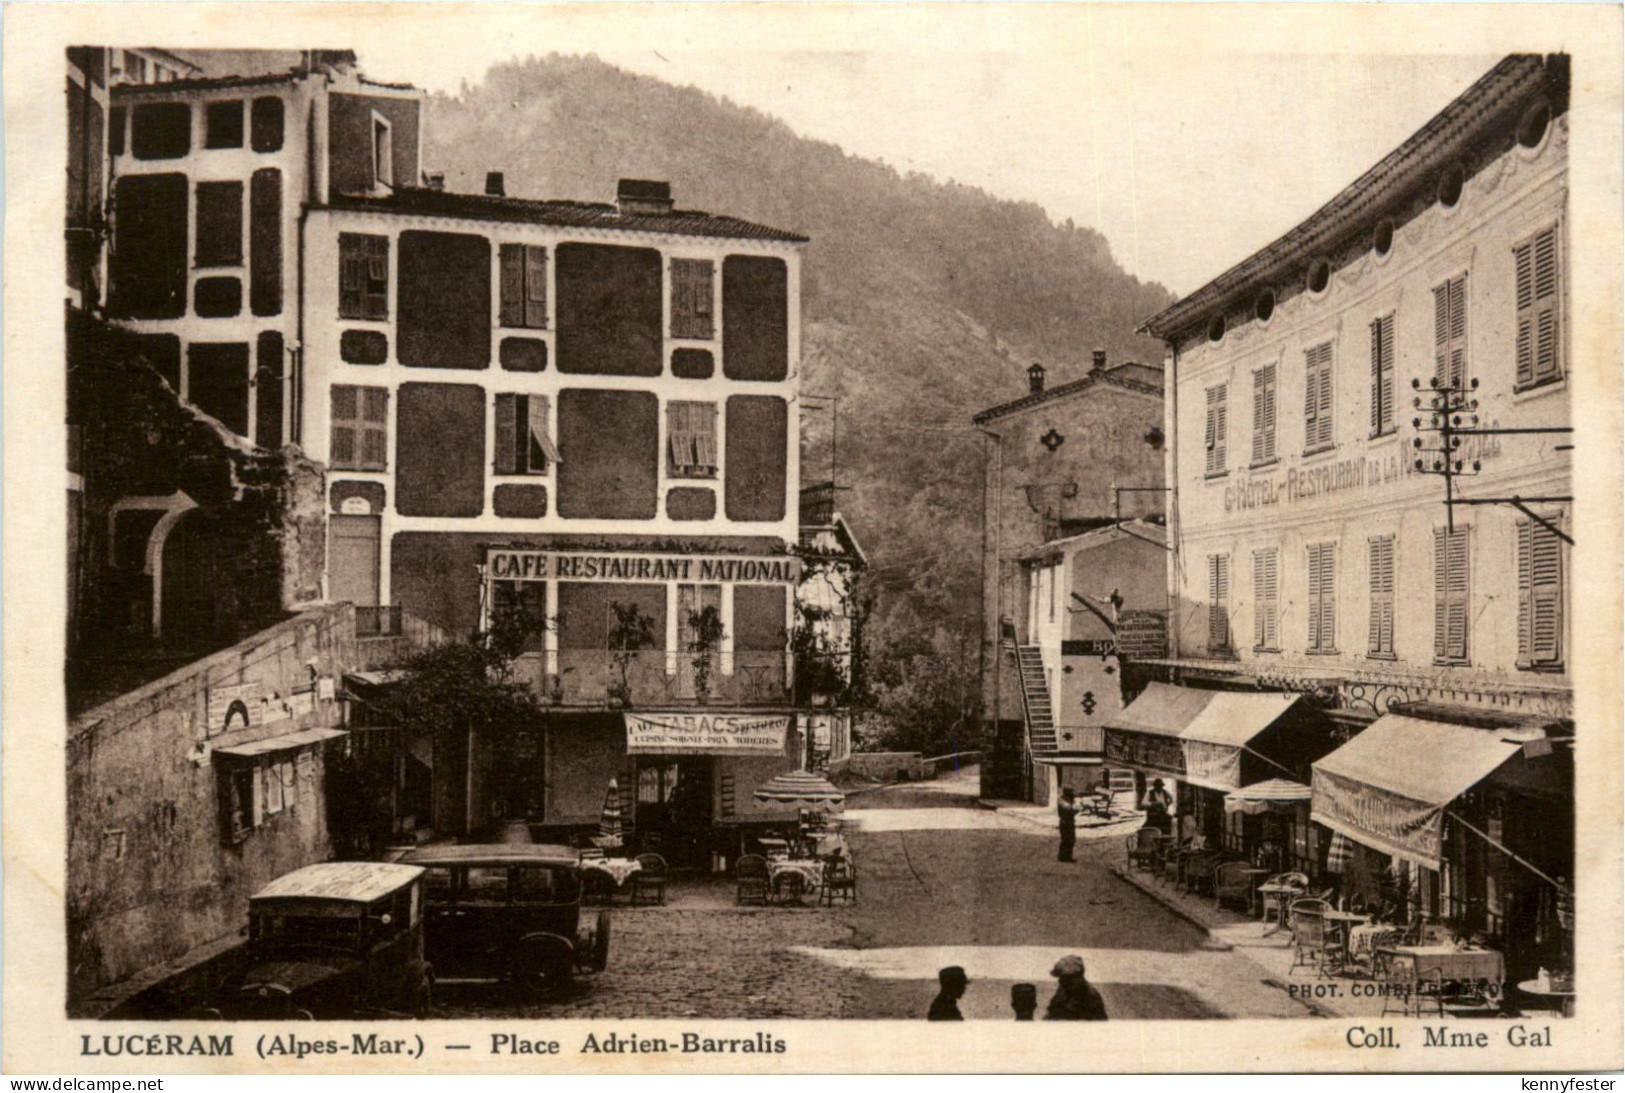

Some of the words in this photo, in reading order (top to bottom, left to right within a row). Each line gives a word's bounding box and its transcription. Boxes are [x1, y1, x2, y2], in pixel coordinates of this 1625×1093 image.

[555, 555, 692, 580] RESTAURANT
[700, 559, 796, 583] NATIONAL
[658, 716, 740, 734] TABACS
